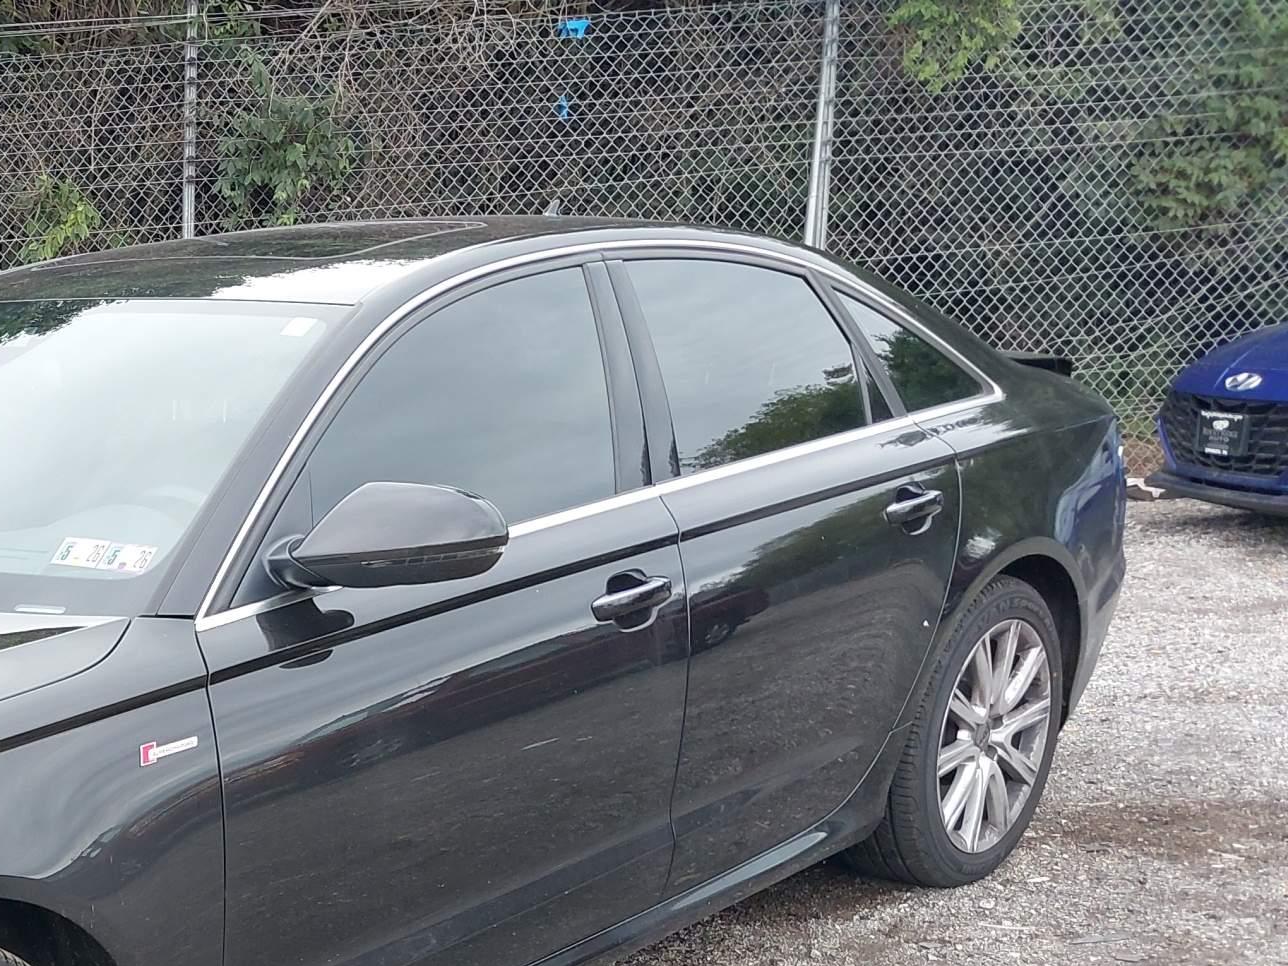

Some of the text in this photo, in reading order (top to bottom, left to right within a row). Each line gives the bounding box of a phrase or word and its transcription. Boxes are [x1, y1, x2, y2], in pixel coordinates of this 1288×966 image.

[61, 544, 105, 562] 5 26
[107, 549, 152, 568] 5 26
